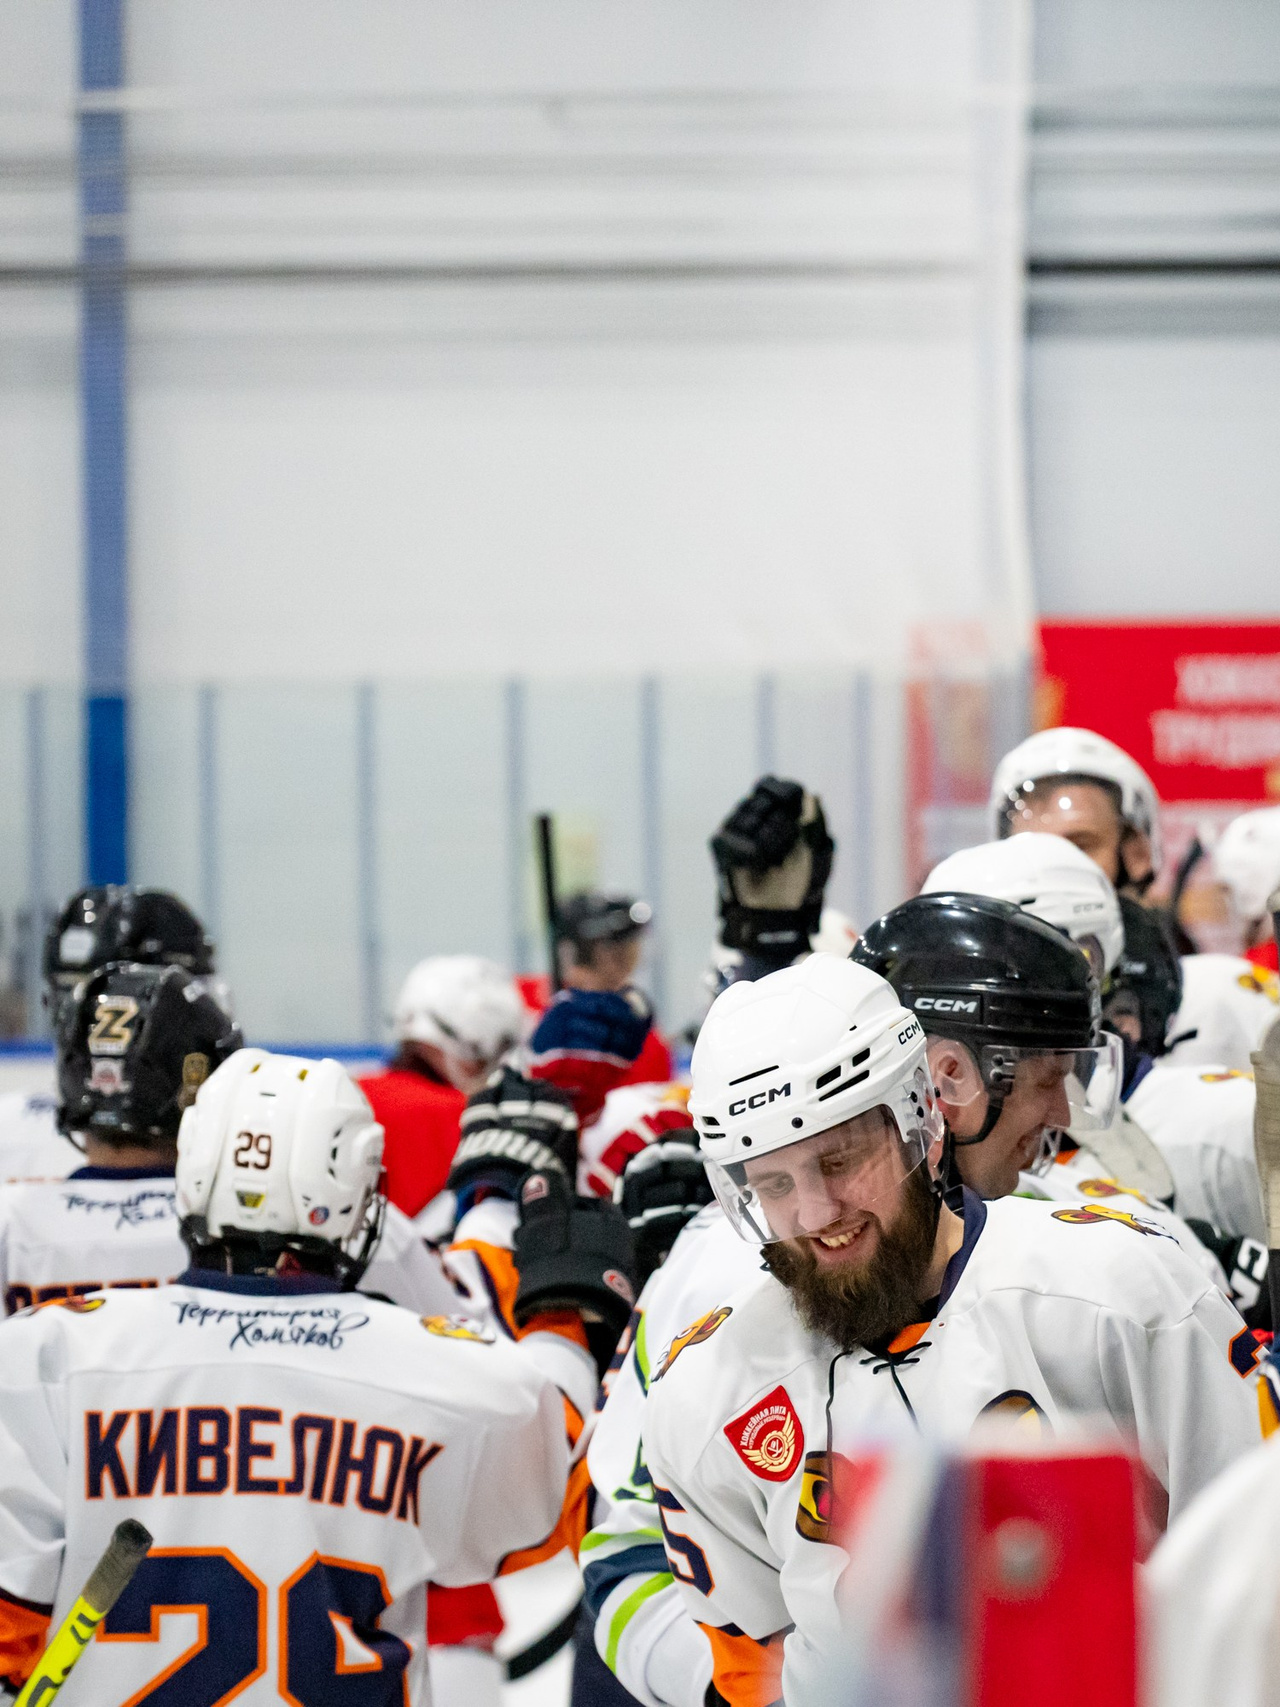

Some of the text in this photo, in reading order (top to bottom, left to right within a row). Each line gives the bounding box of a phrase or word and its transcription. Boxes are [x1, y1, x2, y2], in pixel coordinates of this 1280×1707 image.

[914, 997, 978, 1014] CCM
[898, 1021, 921, 1046] CCM
[729, 1082, 791, 1117] CCM
[234, 1131, 272, 1170] 29
[172, 1301, 341, 1326] Территория
[229, 1312, 370, 1351] Хомяков
[769, 1405, 787, 1416] ЛИГА
[84, 1405, 446, 1528] КИВЕЛЮК
[96, 1546, 413, 1707] 29
